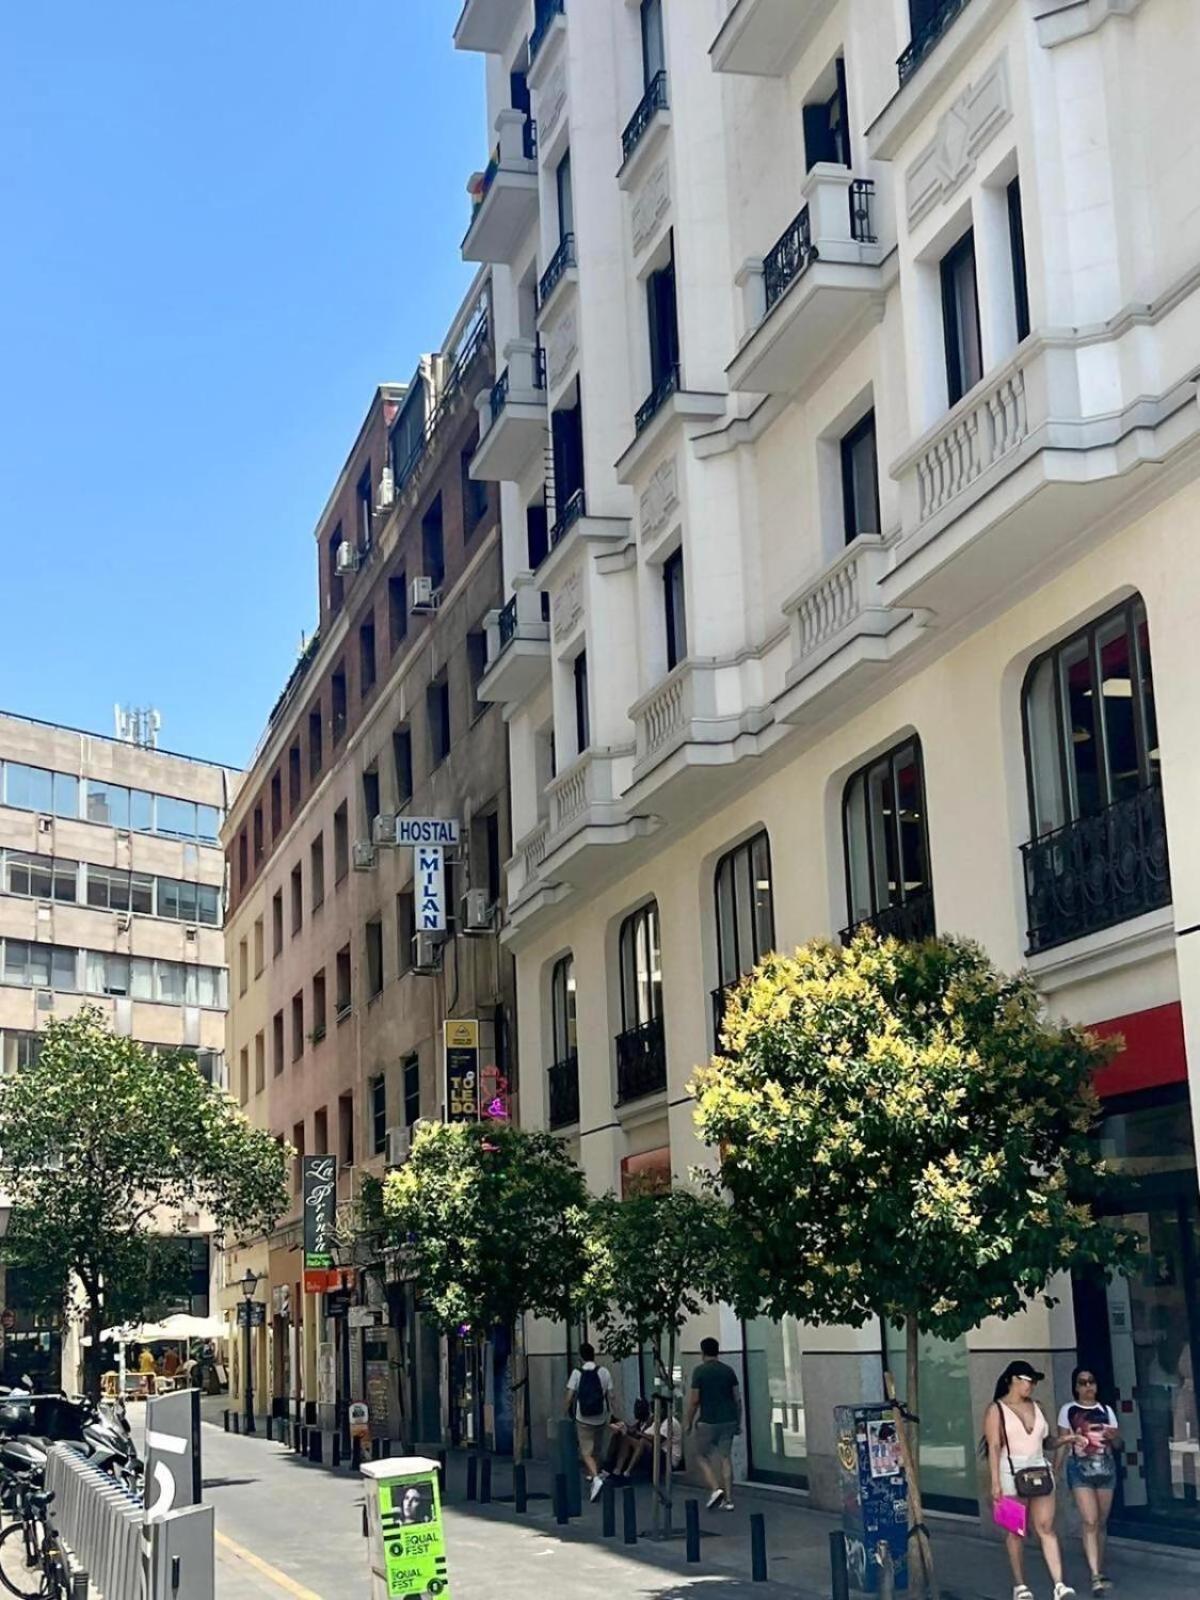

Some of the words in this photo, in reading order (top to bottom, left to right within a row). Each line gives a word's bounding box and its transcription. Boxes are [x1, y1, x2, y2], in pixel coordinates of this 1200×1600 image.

[400, 821, 457, 841] HOSTAL
[420, 858, 439, 928] MILAN
[305, 1160, 334, 1181] La
[406, 1544, 429, 1555] FEST
[392, 1578, 414, 1590] FEST
